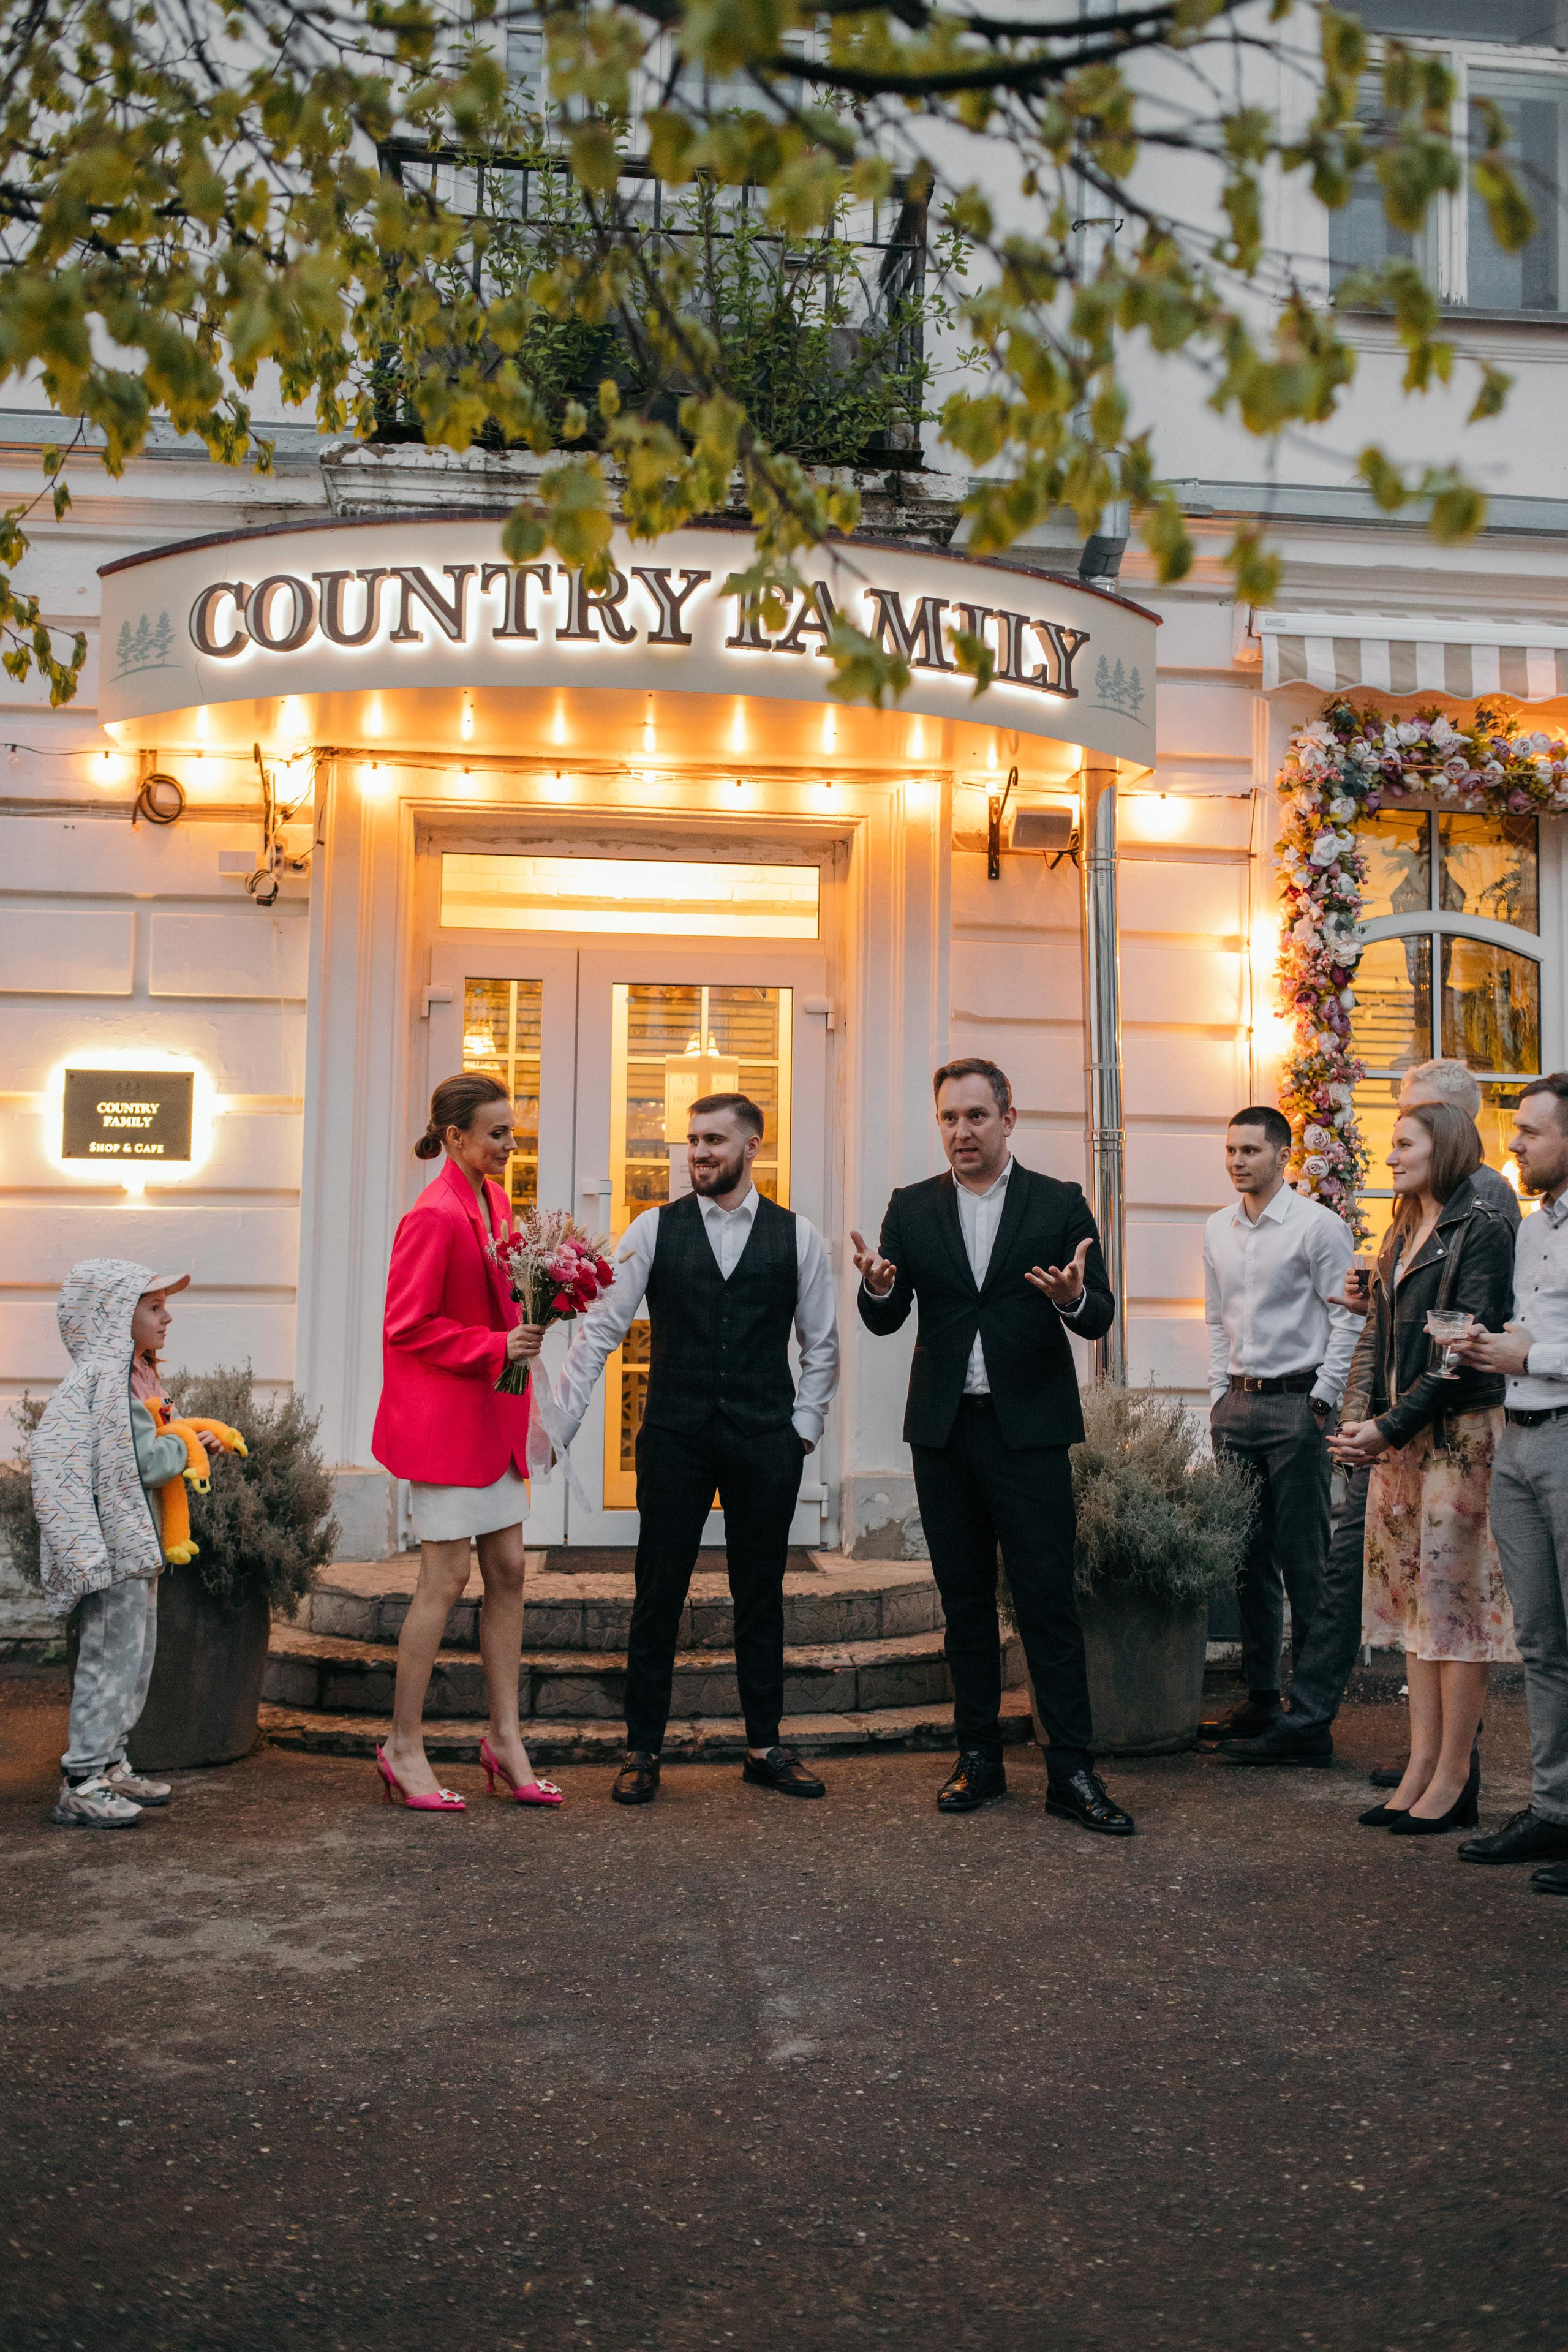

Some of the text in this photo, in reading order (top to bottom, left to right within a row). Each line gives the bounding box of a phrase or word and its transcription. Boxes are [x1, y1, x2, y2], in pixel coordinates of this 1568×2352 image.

[189, 563, 710, 659] COUNTRY
[96, 1102, 160, 1114] COUNTRY
[102, 1116, 153, 1128] FAMILY
[89, 1142, 165, 1154] SHOP & CAFE
